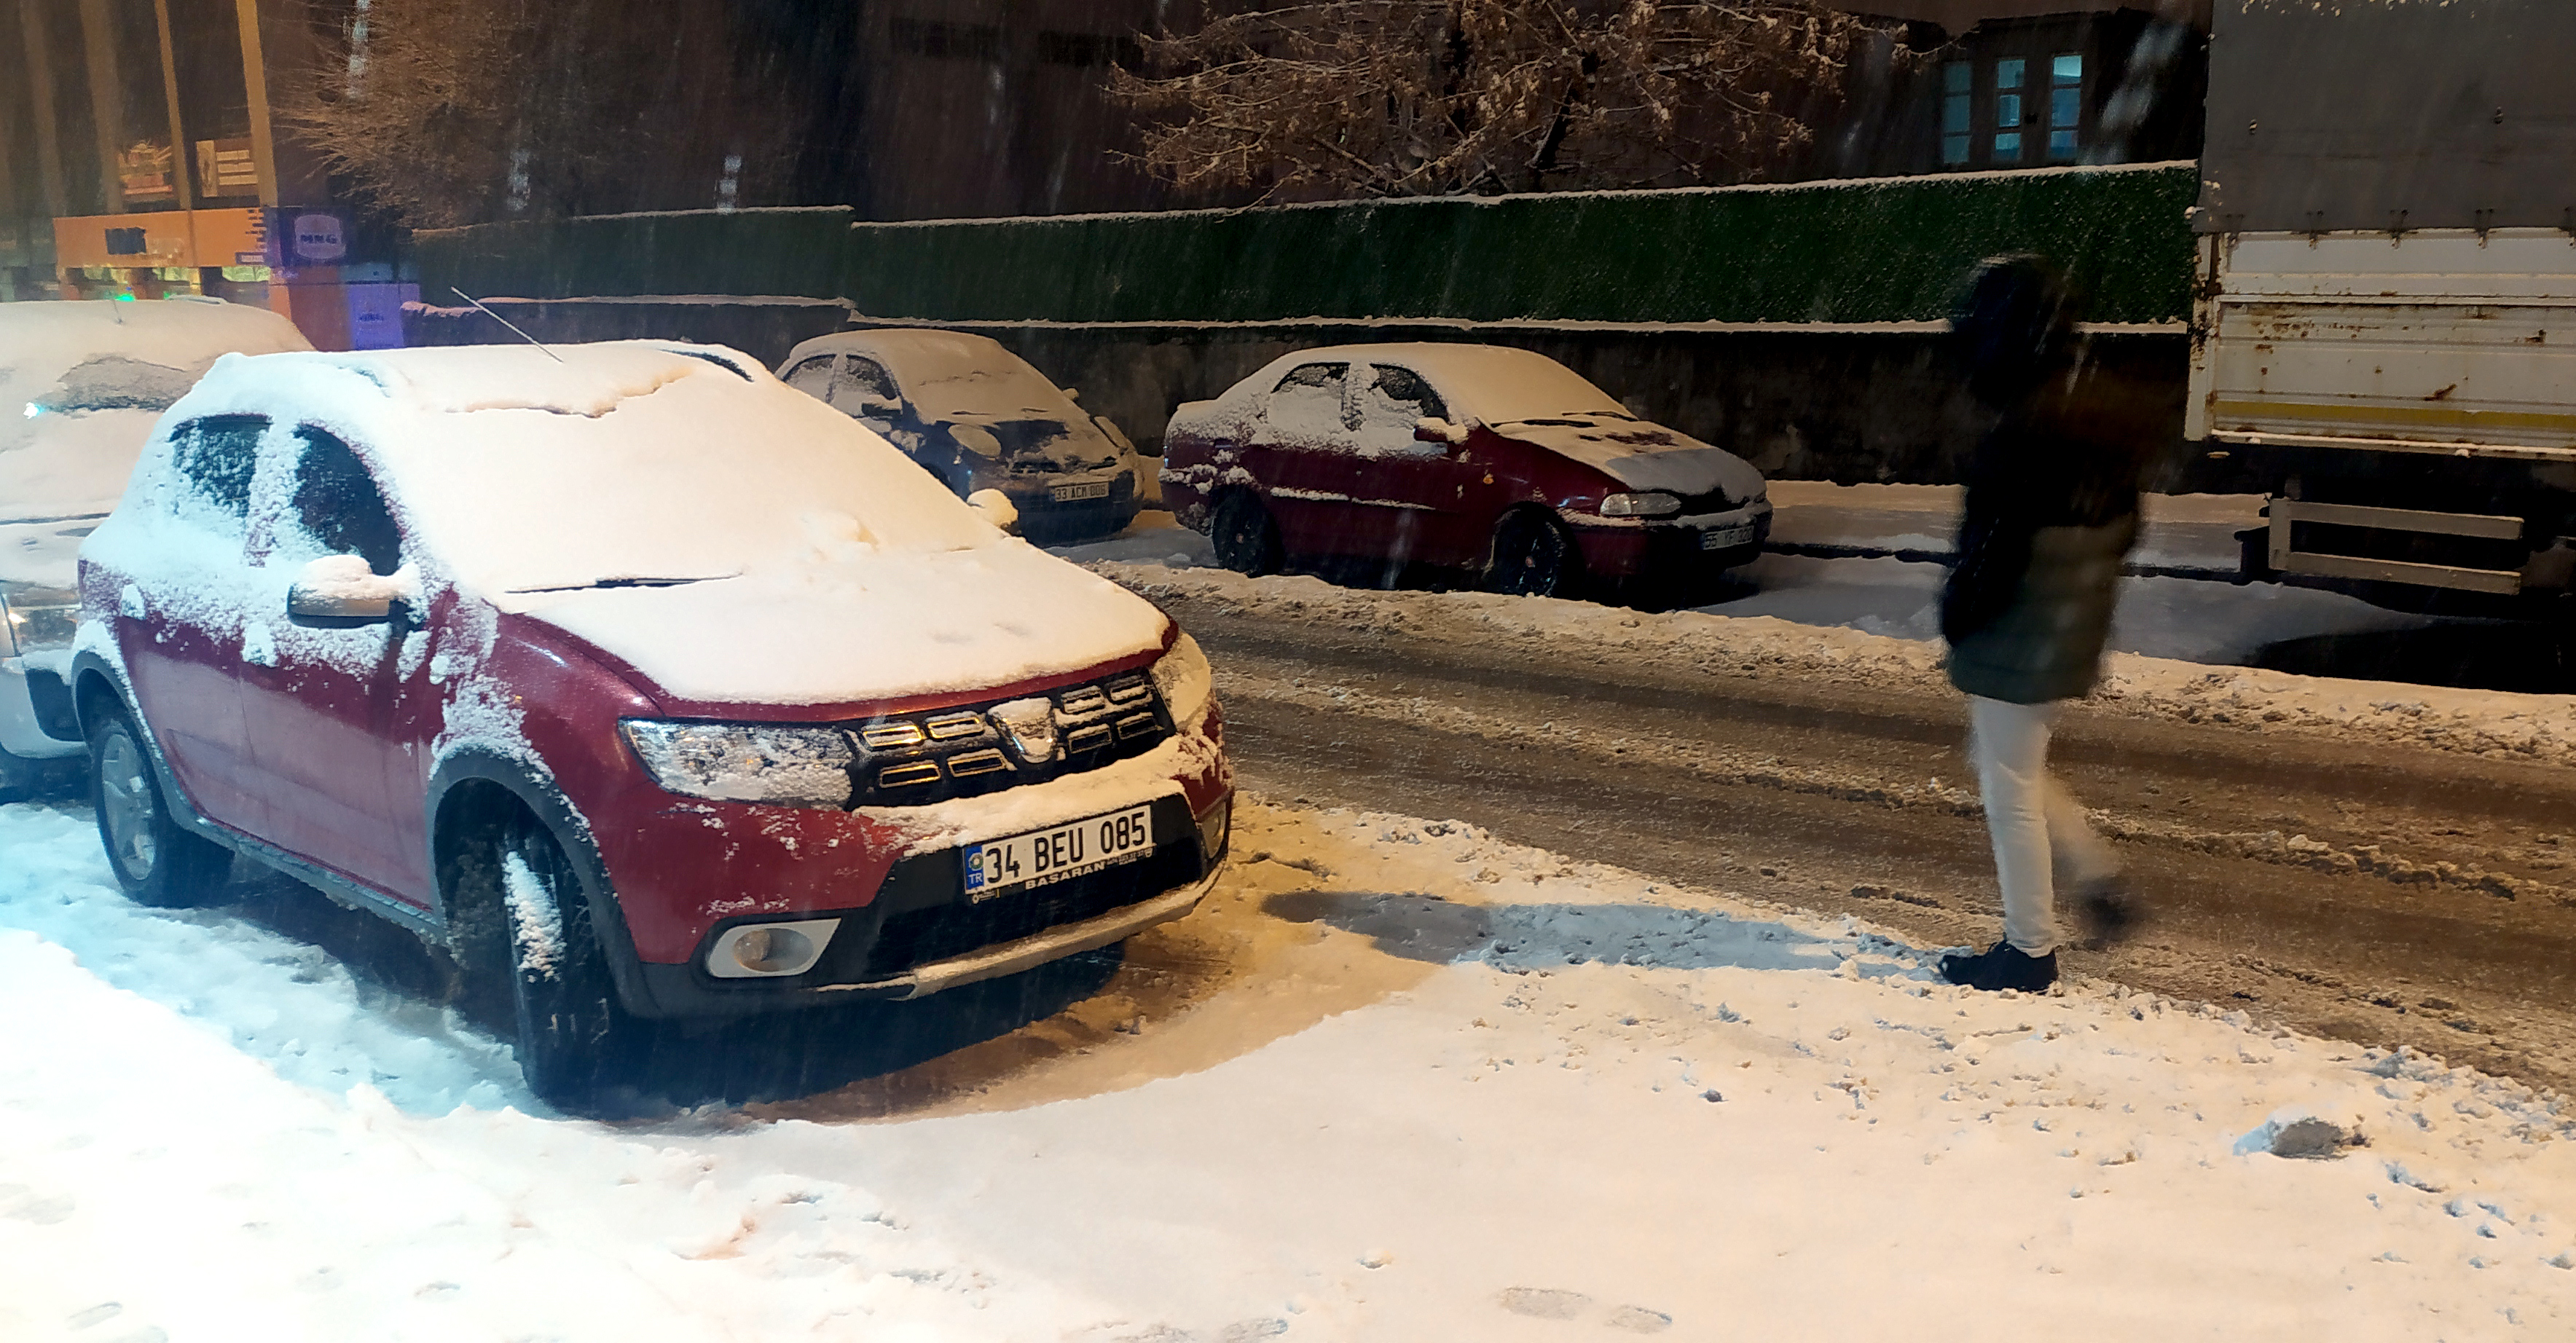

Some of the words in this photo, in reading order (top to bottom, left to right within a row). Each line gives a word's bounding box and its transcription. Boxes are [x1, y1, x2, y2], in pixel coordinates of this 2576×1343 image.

[300, 234, 337, 244] MNG
[1056, 489, 1067, 500] 33
[1705, 532, 1718, 548] 55
[985, 845, 1020, 883] 34
[1034, 827, 1084, 873] BEU
[1100, 811, 1145, 854] 085
[968, 873, 983, 884] TR
[1024, 861, 1106, 890] BASARAN
